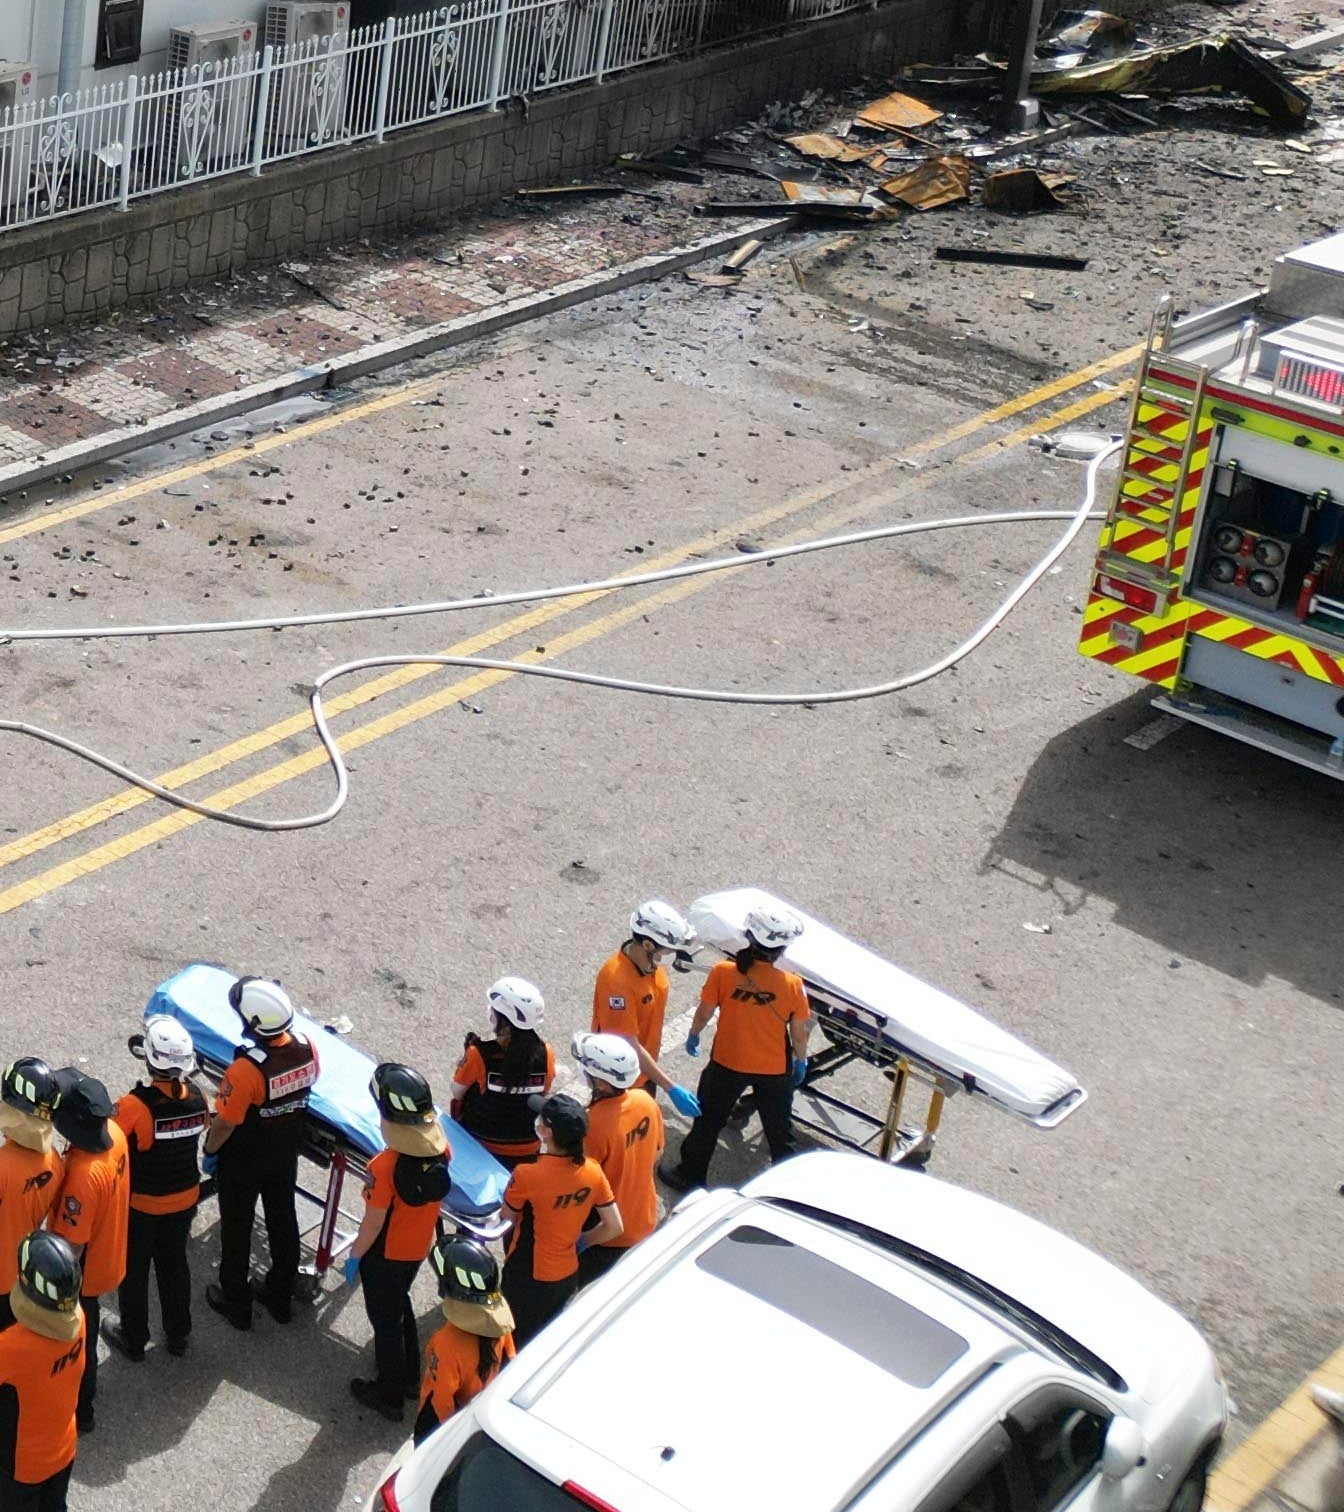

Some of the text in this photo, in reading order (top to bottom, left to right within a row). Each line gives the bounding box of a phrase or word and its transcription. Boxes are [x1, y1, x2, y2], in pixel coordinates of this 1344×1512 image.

[729, 988, 777, 1006] 119
[625, 1116, 651, 1149] 119
[552, 1186, 593, 1210] 119
[50, 1337, 83, 1378] 119
